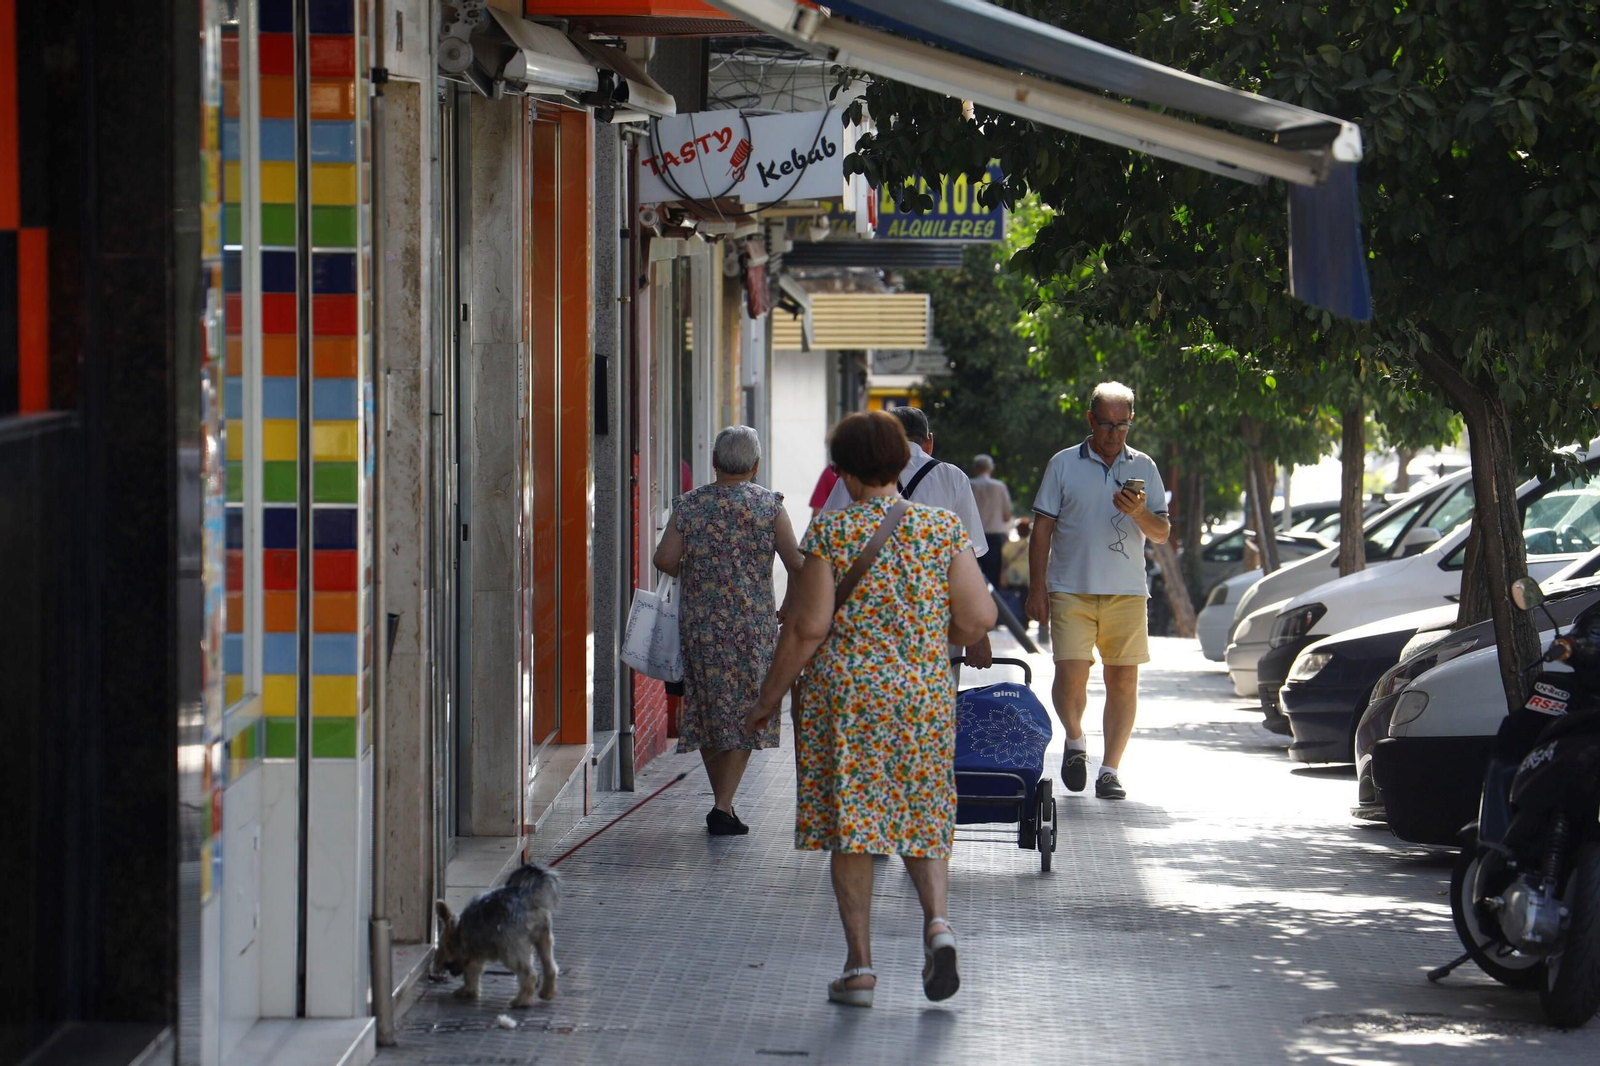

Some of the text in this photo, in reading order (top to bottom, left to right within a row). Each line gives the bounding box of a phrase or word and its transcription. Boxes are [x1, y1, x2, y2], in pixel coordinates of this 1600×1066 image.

[641, 127, 733, 176] TASTY
[756, 136, 837, 188] Kebab
[887, 219, 996, 238] ALQUILERES
[992, 690, 1020, 699] gimi
